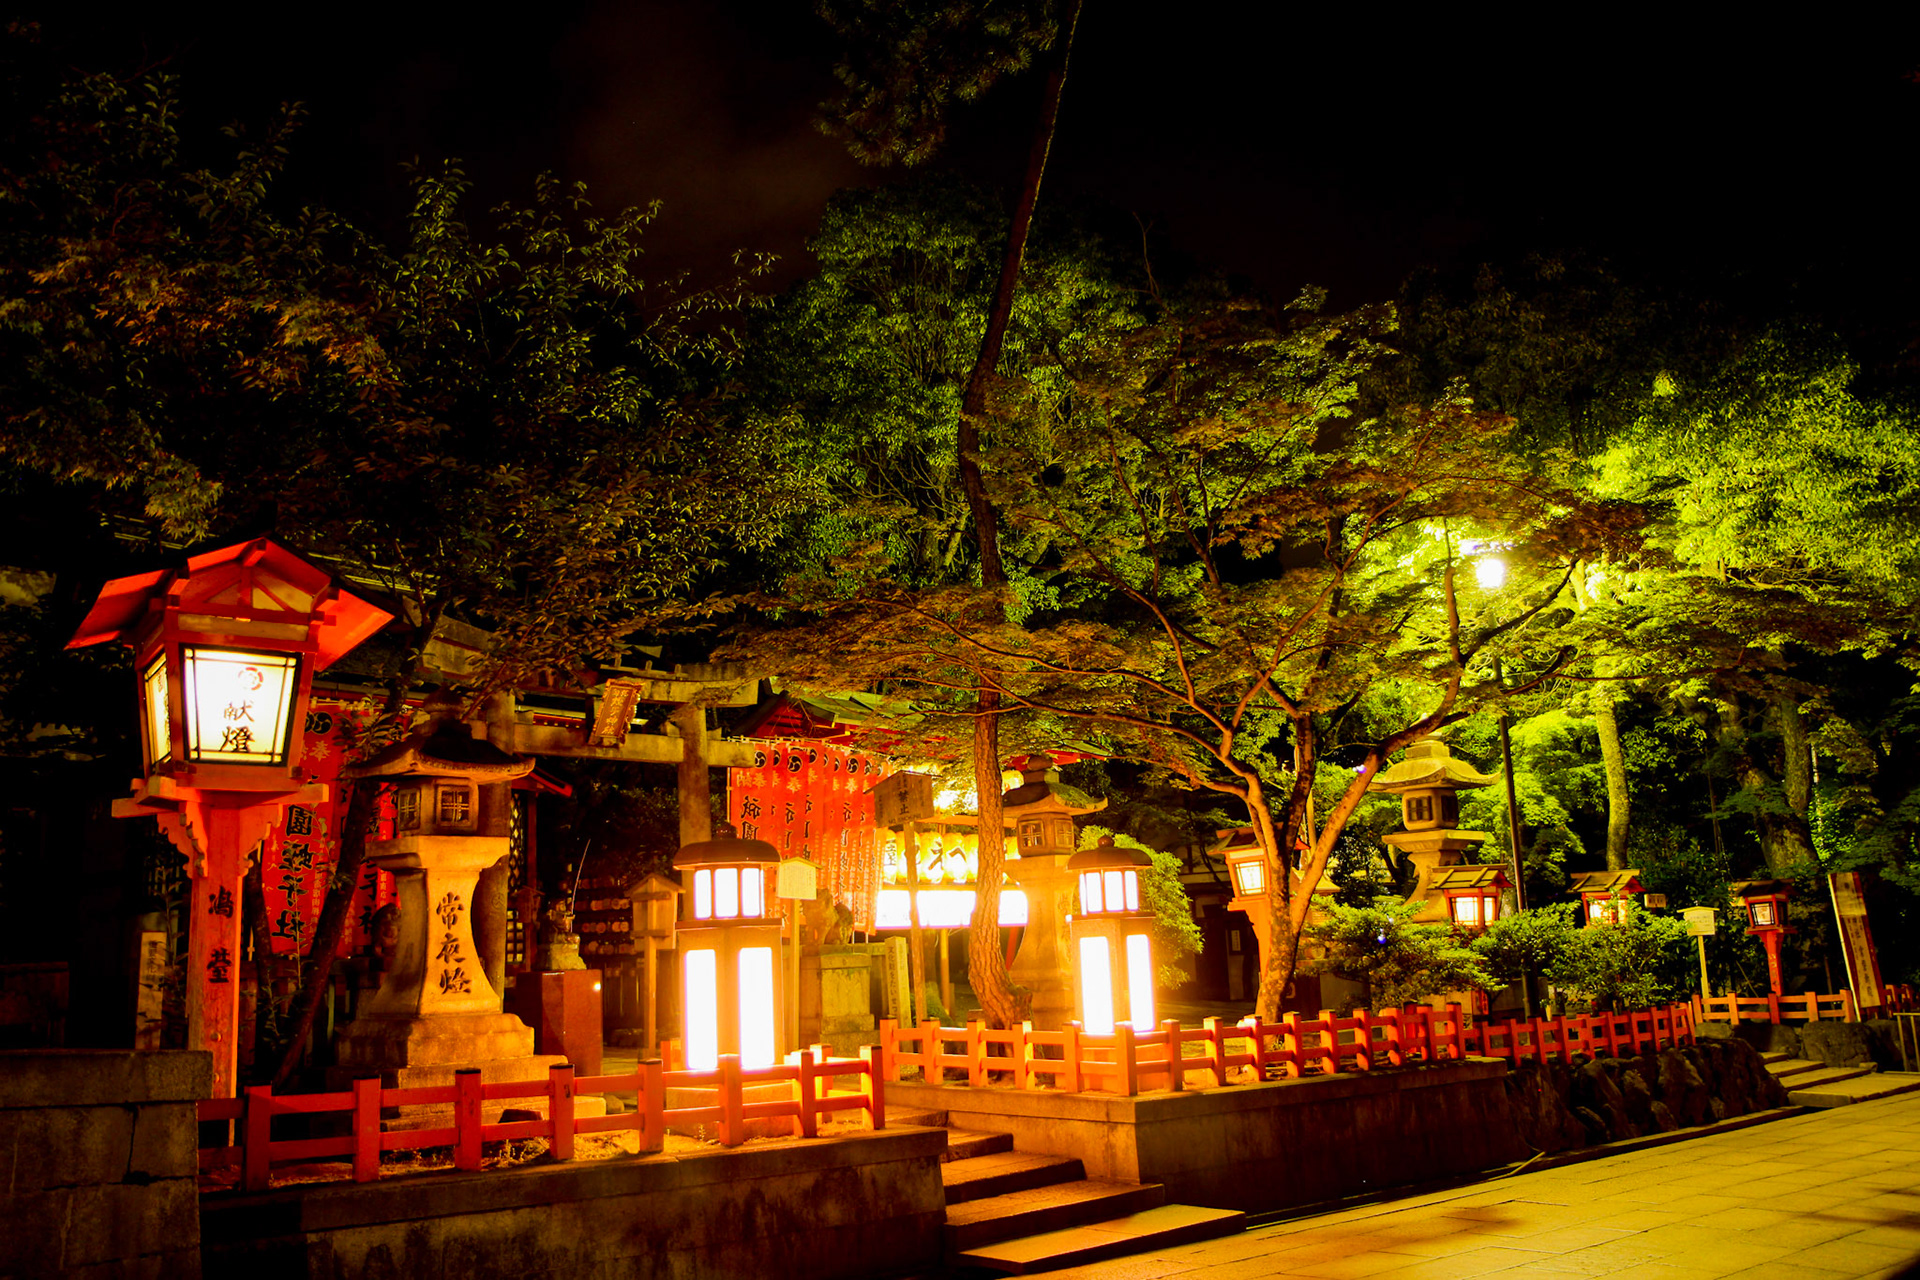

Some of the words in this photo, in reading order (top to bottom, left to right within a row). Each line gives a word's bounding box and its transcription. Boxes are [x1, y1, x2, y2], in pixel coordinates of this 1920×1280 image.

[221, 700, 255, 753] 献燈
[436, 891, 471, 995] 常夜燈
